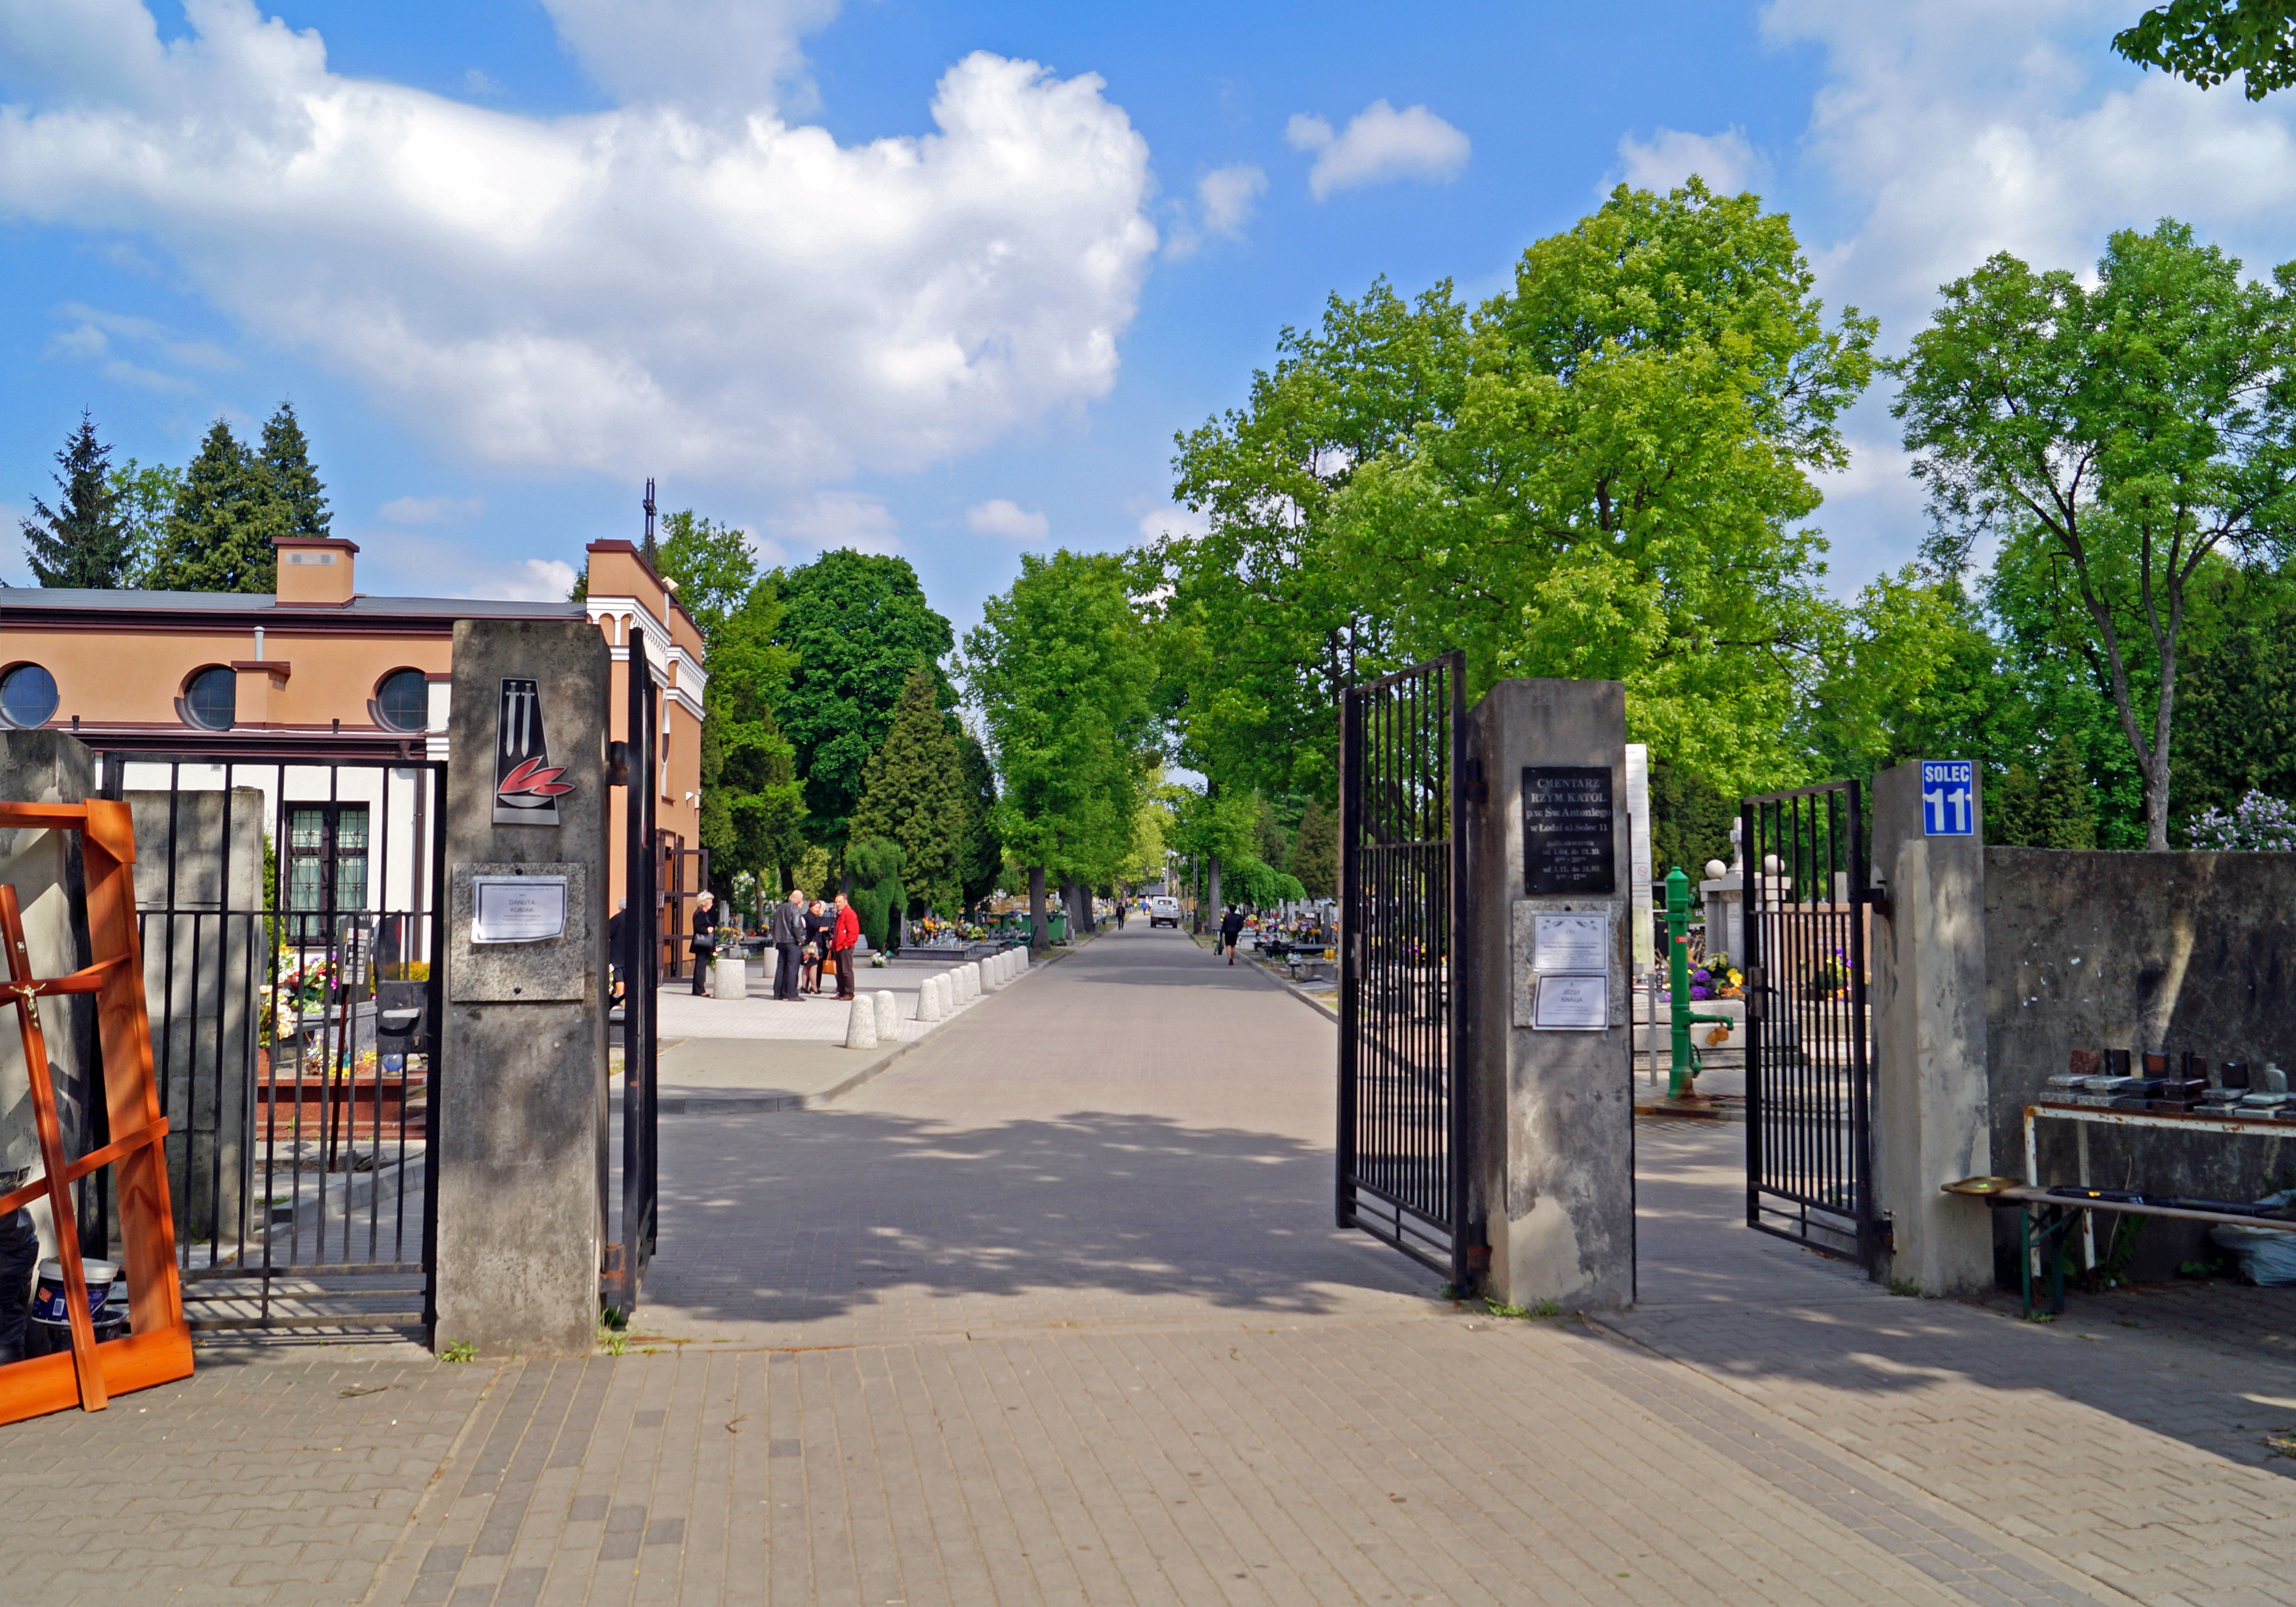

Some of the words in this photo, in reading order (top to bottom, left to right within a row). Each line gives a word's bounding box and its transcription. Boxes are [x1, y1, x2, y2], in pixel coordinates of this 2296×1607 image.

[1925, 766, 1969, 782] SOLEC
[1537, 778, 1600, 788] CMENTARZ
[1562, 807, 1611, 818] Antoniego
[1926, 788, 1966, 831] 11
